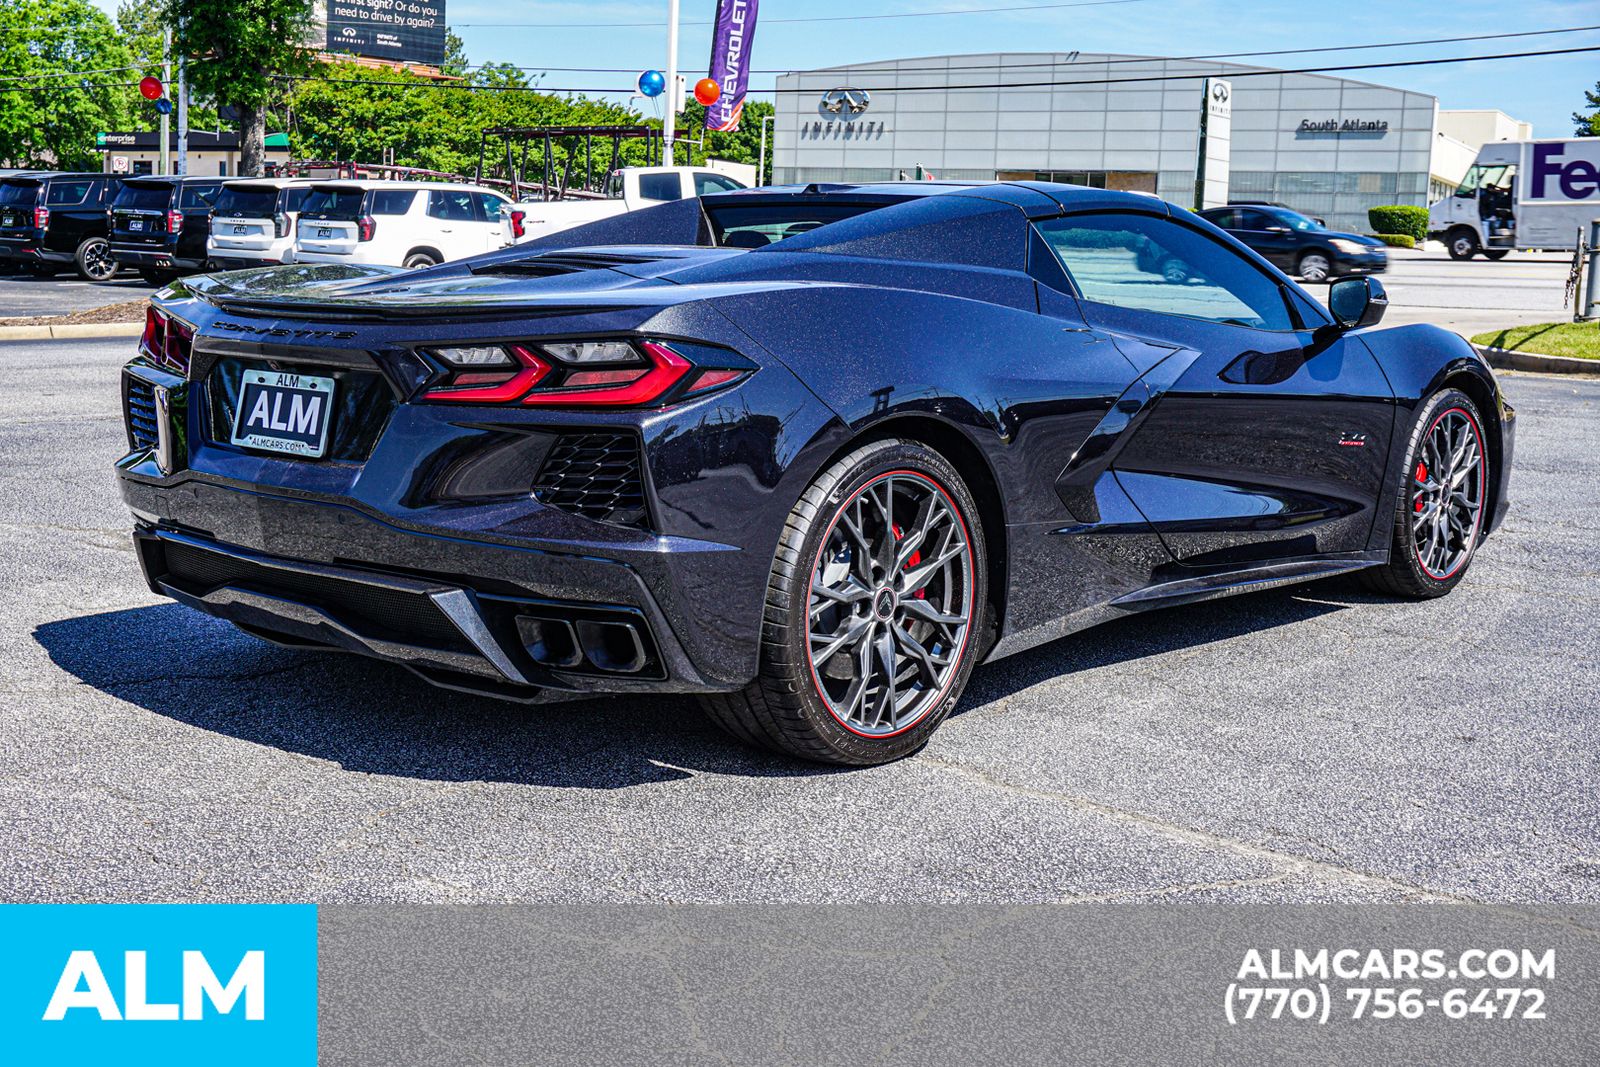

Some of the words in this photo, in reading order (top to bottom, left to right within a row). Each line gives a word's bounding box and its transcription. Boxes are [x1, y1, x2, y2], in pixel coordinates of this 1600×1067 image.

[395, 1, 407, 11] Or
[408, 3, 420, 13] do
[421, 7, 438, 16] you
[335, 7, 357, 17] need
[360, 9, 369, 19] to
[371, 11, 392, 22] drive
[394, 13, 405, 26] by
[407, 17, 435, 28] again?
[721, 0, 746, 121] CHEVROLET
[804, 121, 885, 133] INFINITI
[1301, 119, 1338, 131] South
[1341, 119, 1388, 131] Atlanta
[1530, 143, 1600, 199] Fe
[212, 321, 358, 338] CORVETTE
[276, 373, 299, 388] ALM
[246, 390, 321, 435] ALM
